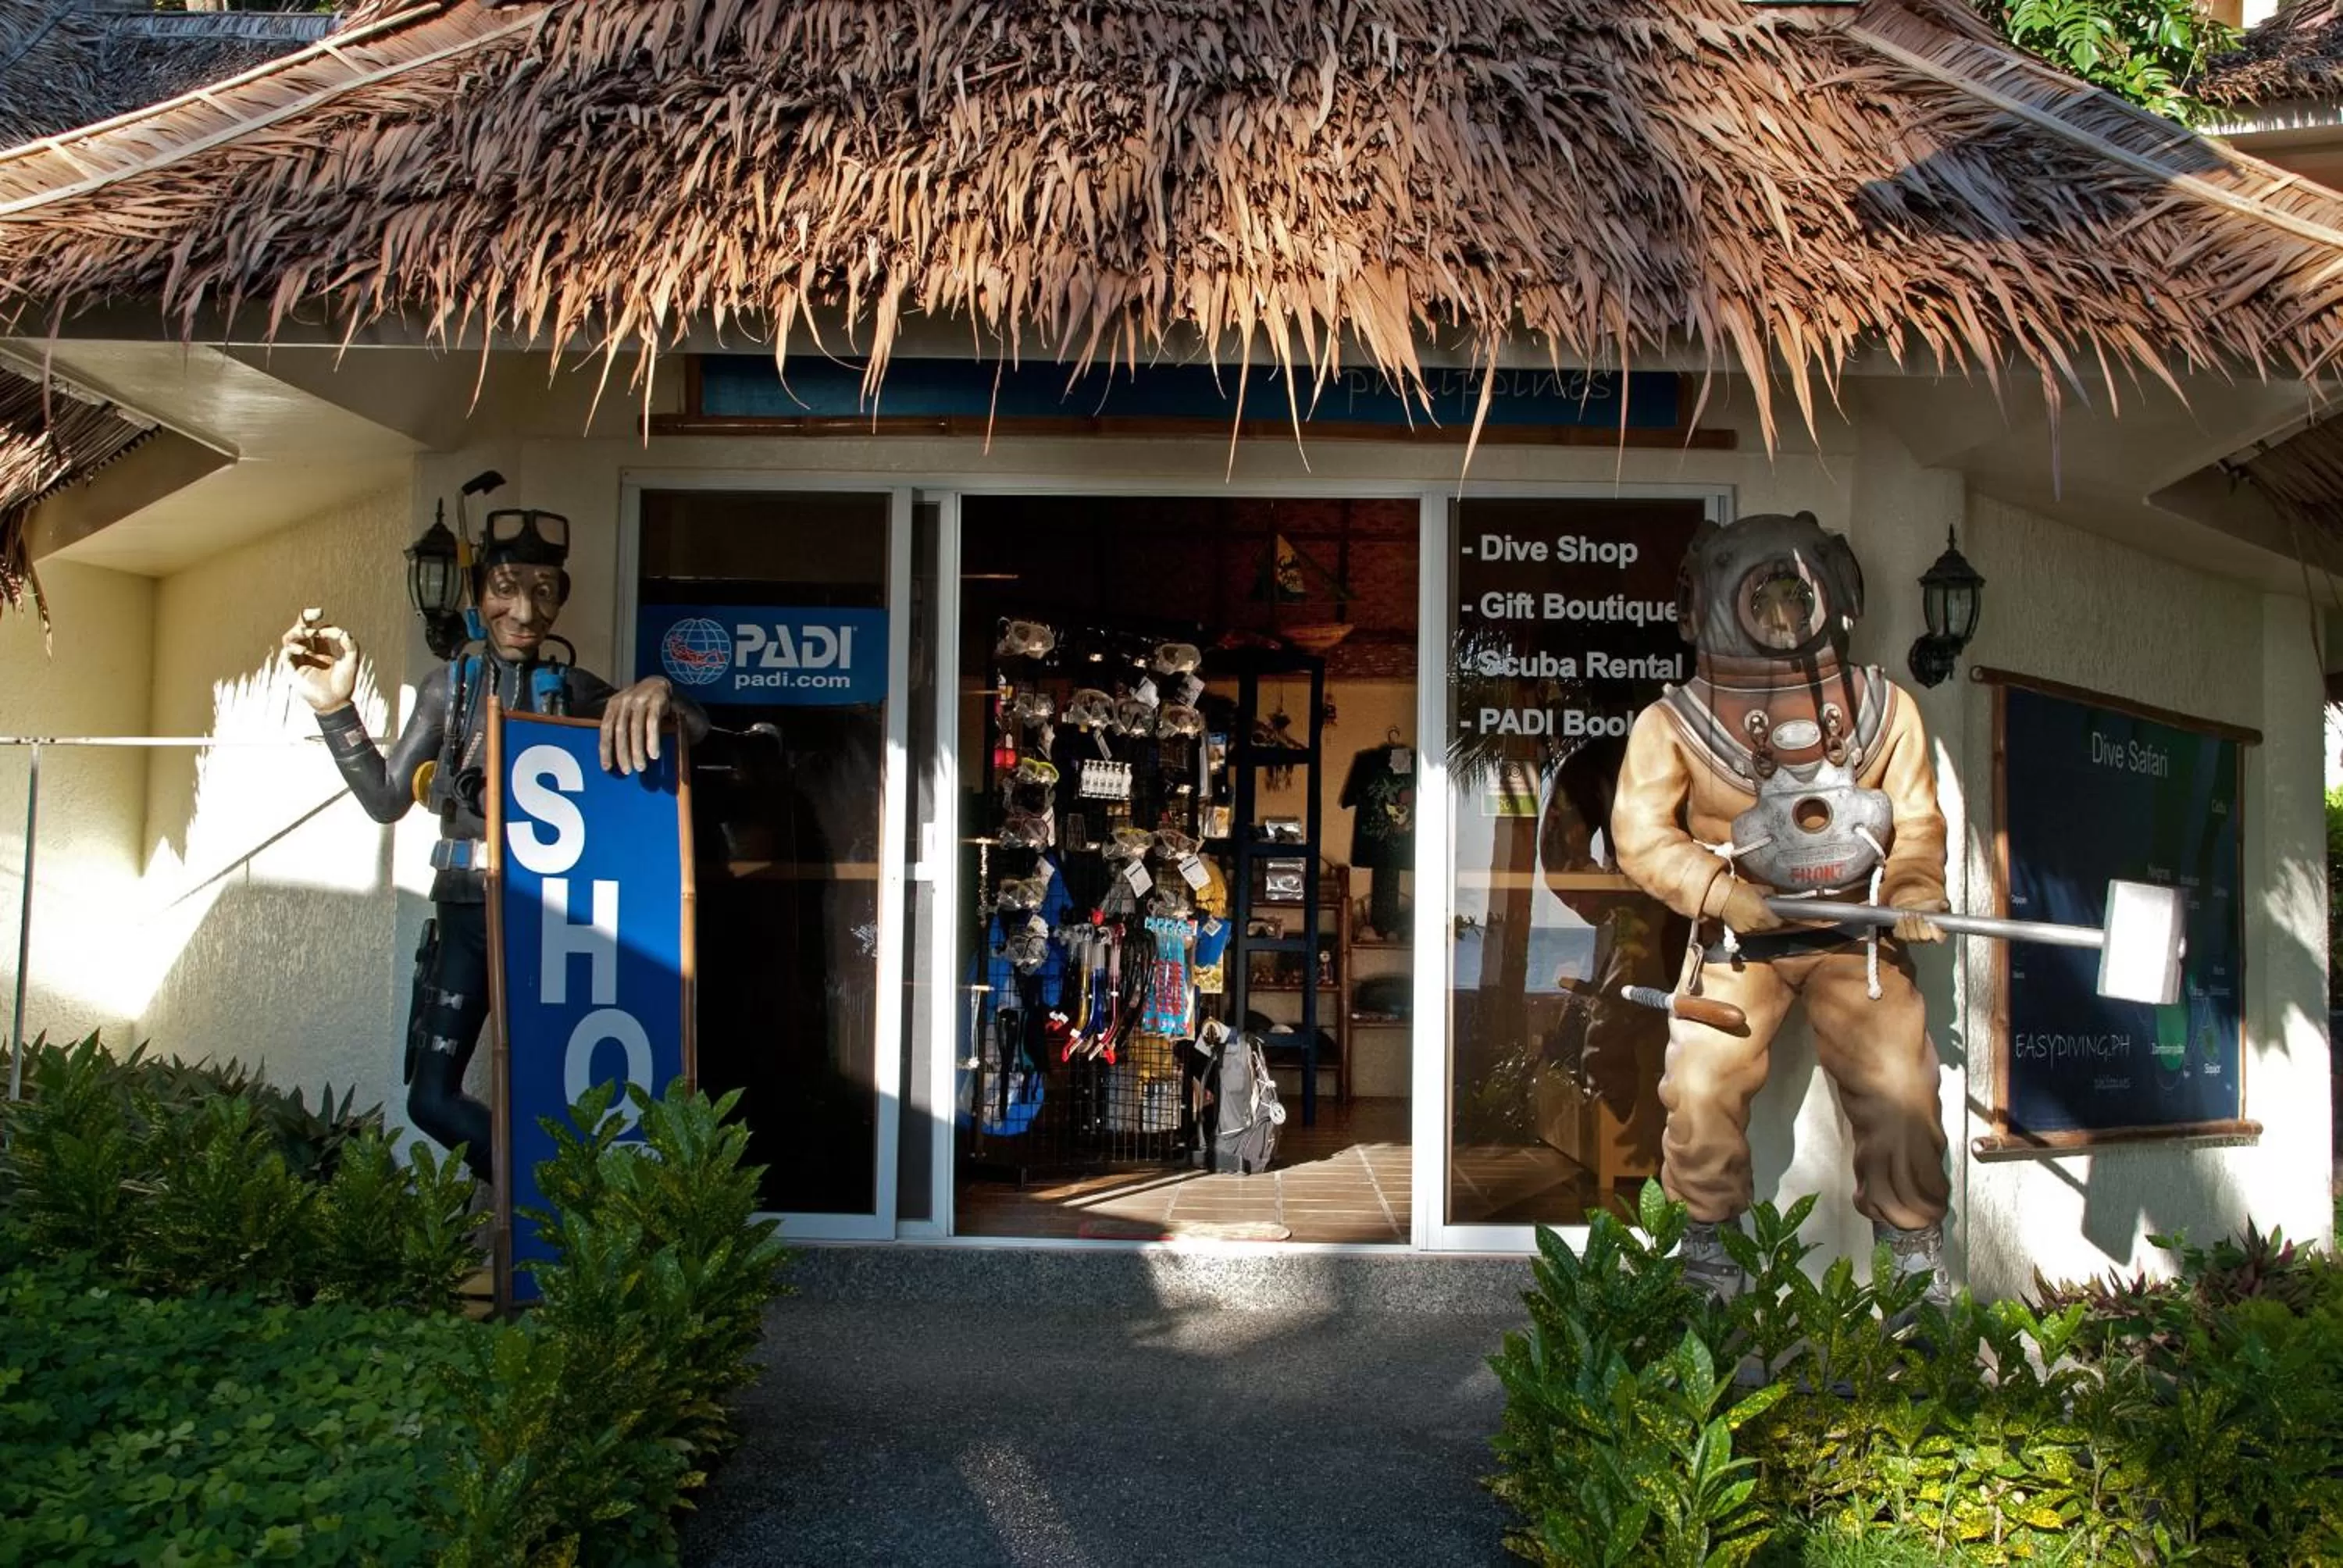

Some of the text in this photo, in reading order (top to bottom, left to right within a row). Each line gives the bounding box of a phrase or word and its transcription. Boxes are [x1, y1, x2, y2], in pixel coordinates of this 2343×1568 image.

[1481, 534, 1638, 569] Dive Shop
[1480, 592, 1678, 627] Gift Boutique
[735, 624, 851, 668] PADI
[734, 671, 851, 690] padi.com
[1478, 650, 1682, 679] Scuba Rental
[1479, 707, 1553, 736] PADI
[2092, 731, 2169, 779] Dive Safari
[506, 744, 662, 1162] SHO
